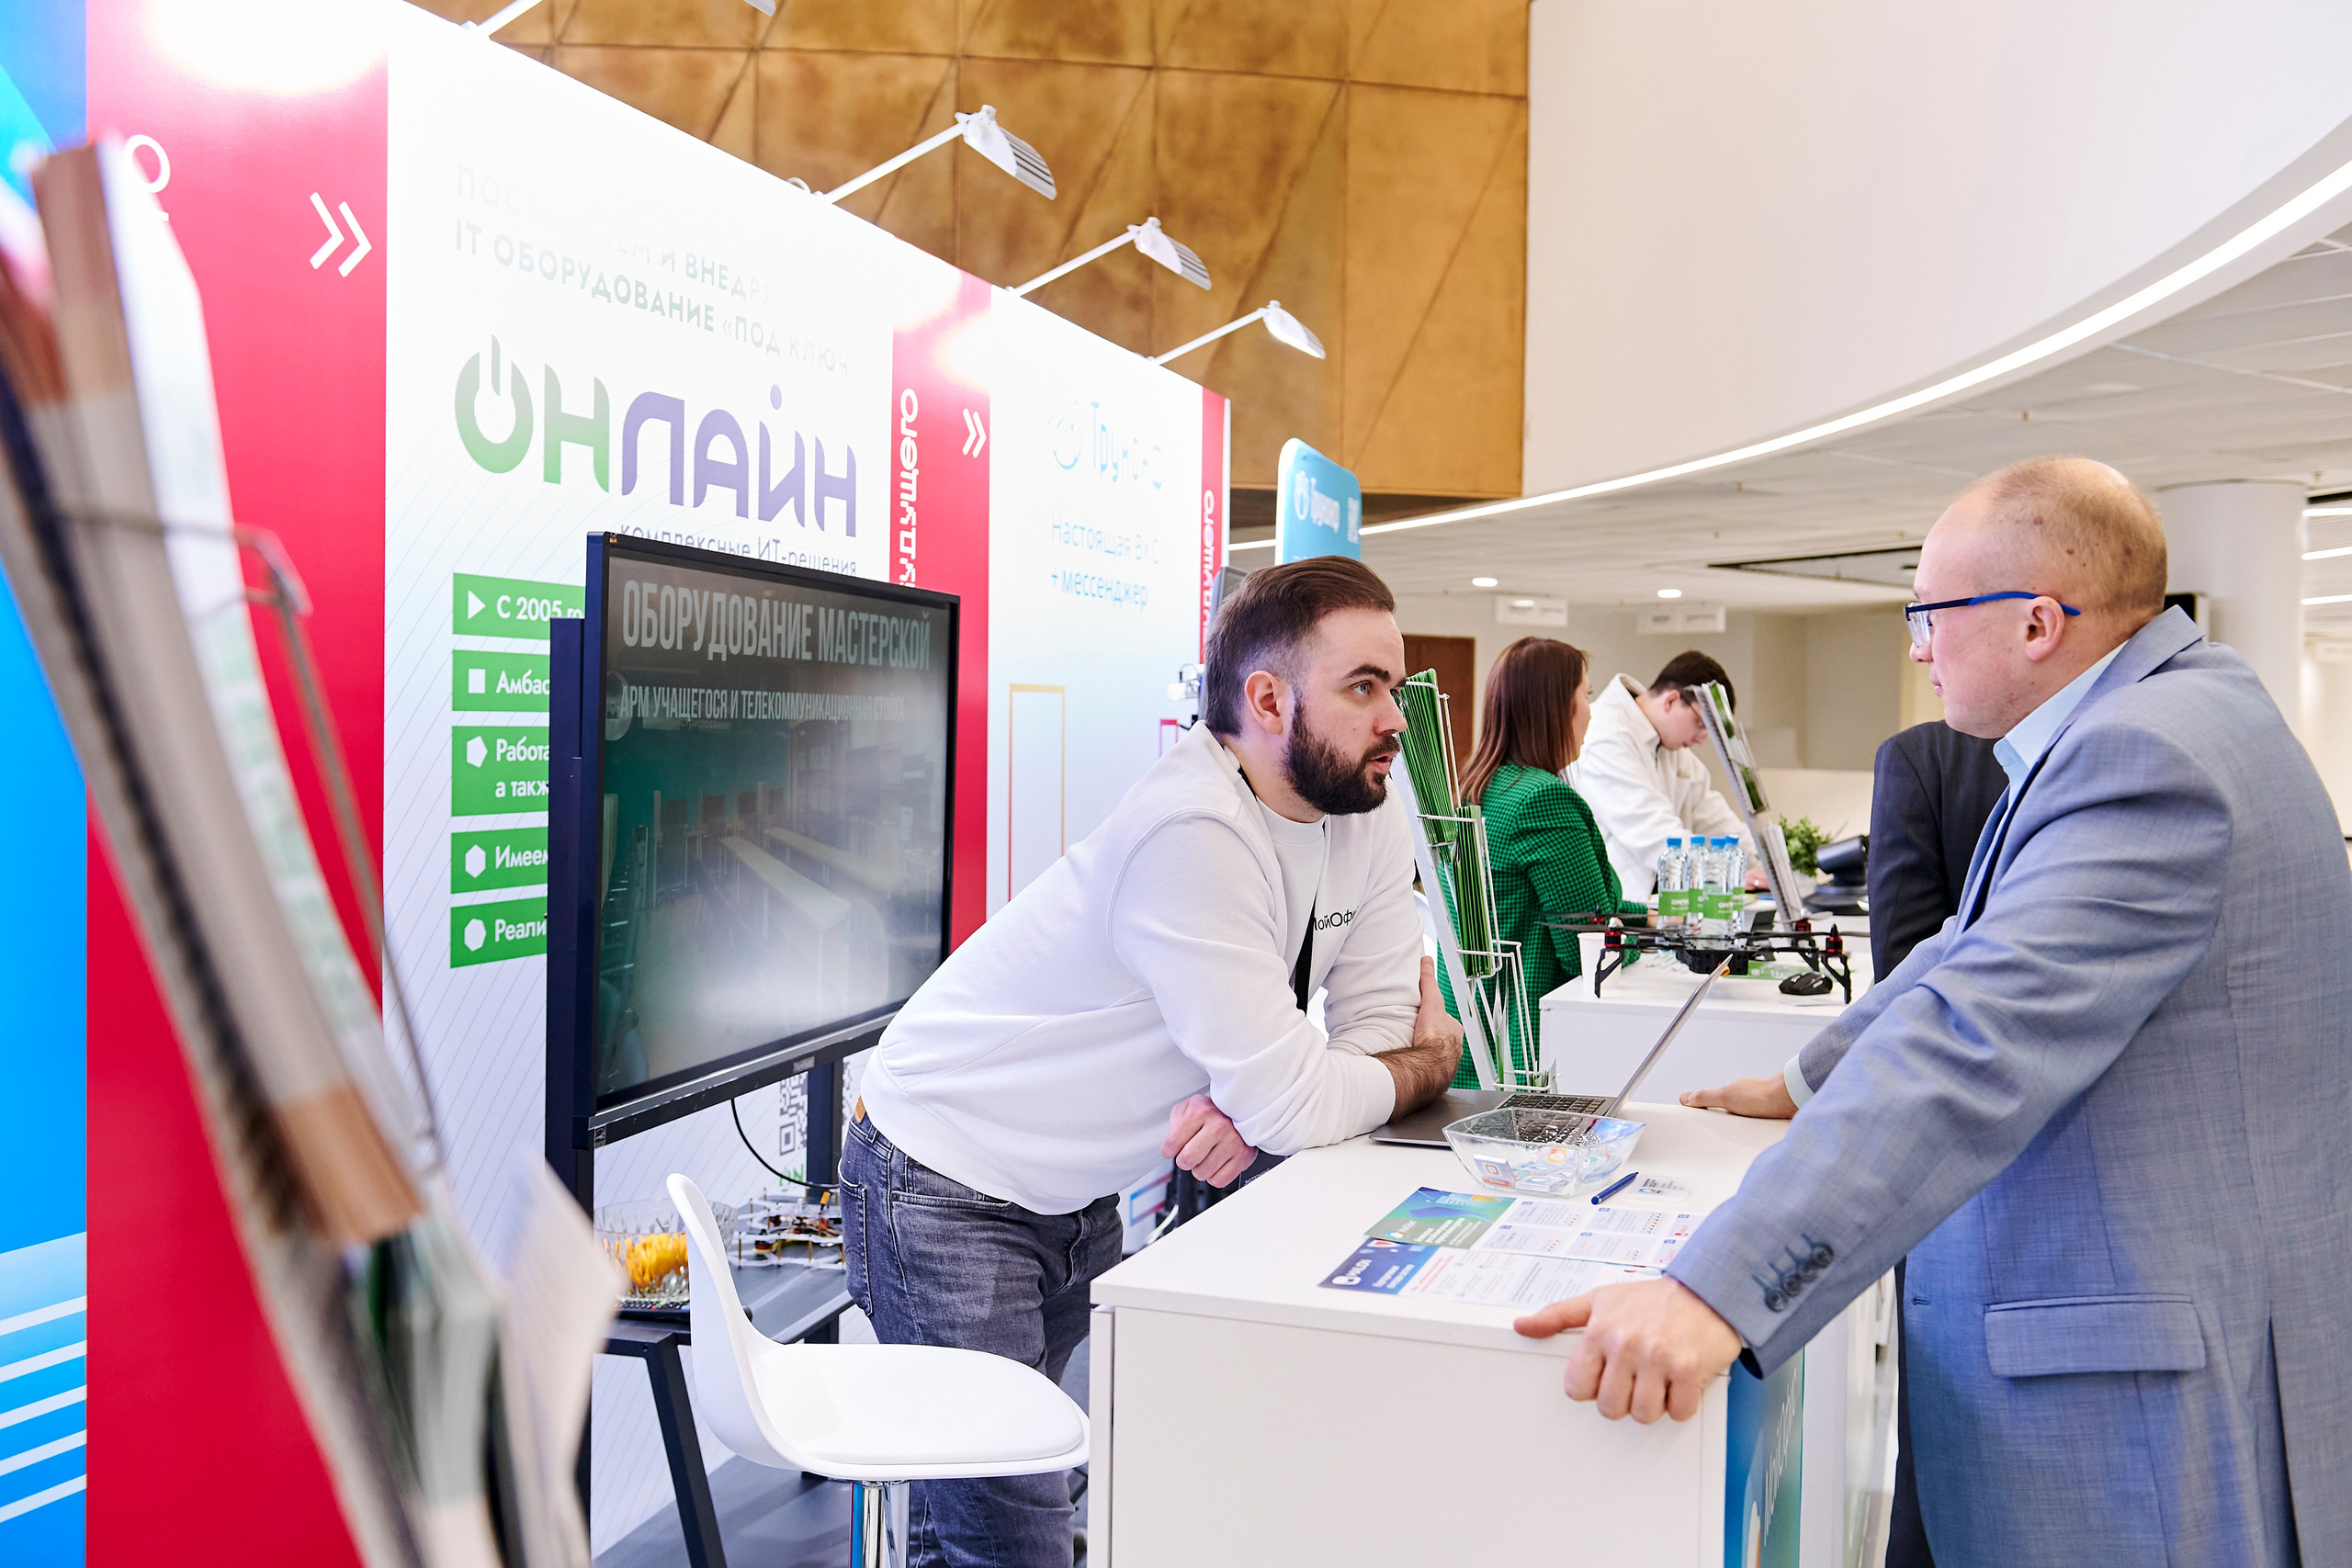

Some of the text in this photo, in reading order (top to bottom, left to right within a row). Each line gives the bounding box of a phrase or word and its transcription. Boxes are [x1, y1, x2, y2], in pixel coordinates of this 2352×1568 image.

[493, 232, 715, 333] ОБОРУДОВАНИЕ
[454, 333, 856, 538] ОНЛАЙН
[496, 594, 512, 619] С
[515, 596, 562, 622] 2005
[622, 580, 931, 671] ОБОРУДОВАНИЕ МАСТЕРСКОЙ
[496, 669, 550, 695] Амбас
[619, 685, 650, 718] АРМ
[653, 686, 729, 722] УЧАЩЕГОСЯ
[730, 689, 739, 719] И
[495, 782, 506, 798] а
